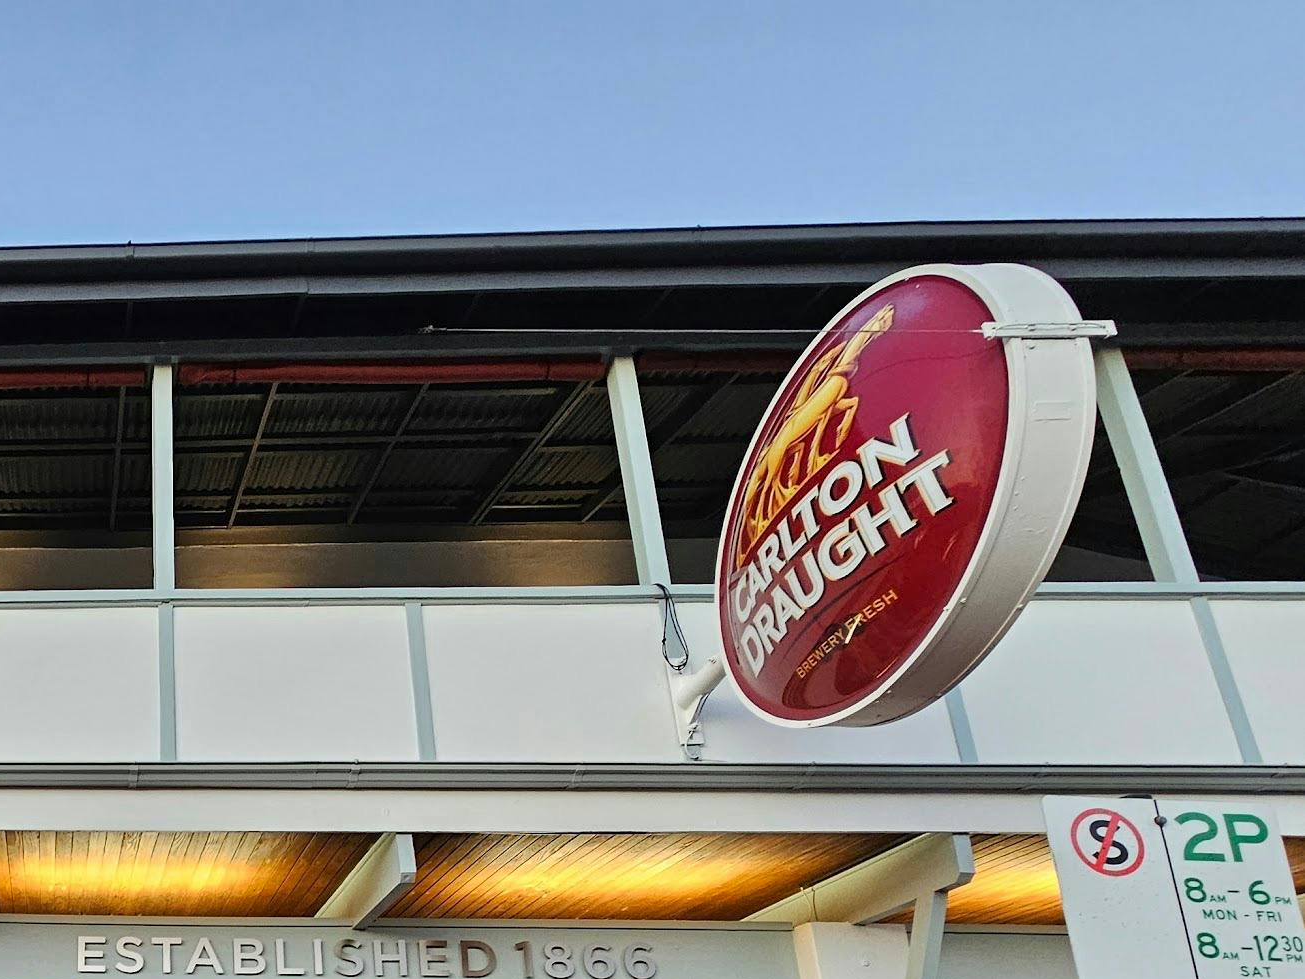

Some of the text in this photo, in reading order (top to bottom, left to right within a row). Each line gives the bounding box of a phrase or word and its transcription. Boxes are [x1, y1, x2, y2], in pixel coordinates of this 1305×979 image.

[731, 411, 920, 624] CARLTON
[740, 449, 954, 678] DRAUGHT
[796, 589, 899, 679] BREWERY FRESH
[1174, 811, 1269, 862] 2P
[1202, 909, 1238, 921] MON
[1256, 910, 1283, 922] FRI
[76, 935, 497, 979] ESTABLISHED
[1240, 966, 1272, 978] SAT
